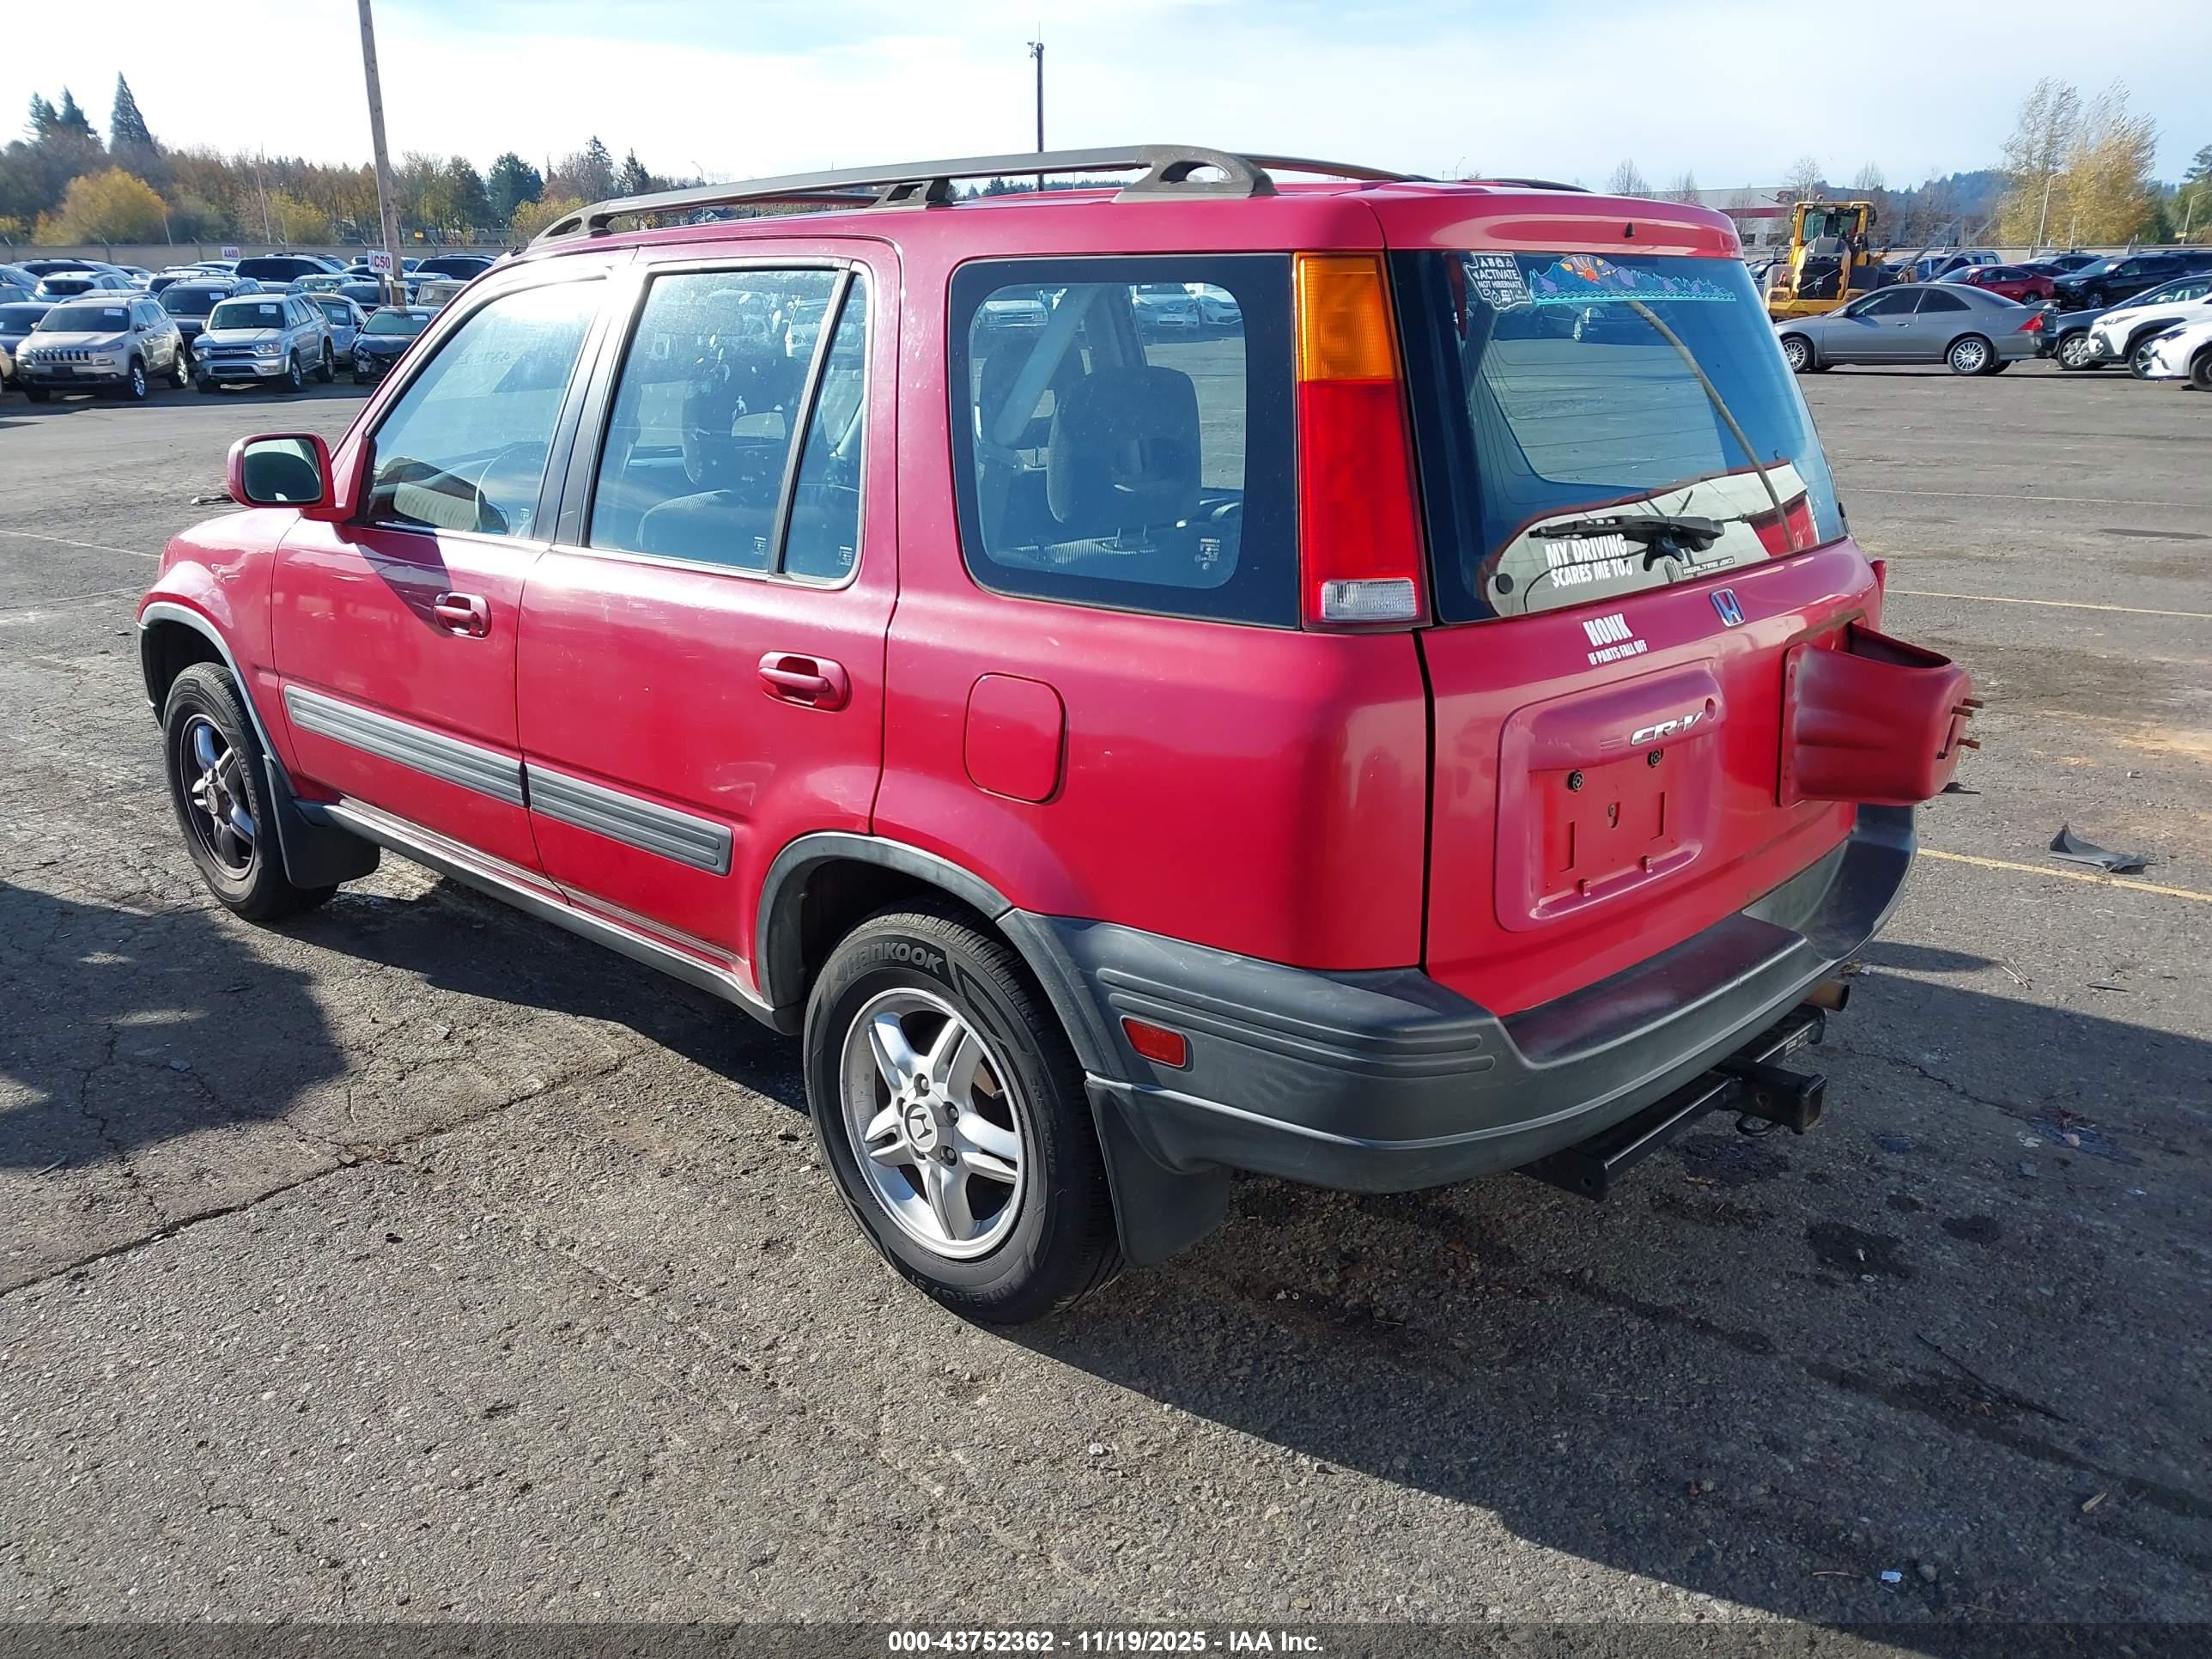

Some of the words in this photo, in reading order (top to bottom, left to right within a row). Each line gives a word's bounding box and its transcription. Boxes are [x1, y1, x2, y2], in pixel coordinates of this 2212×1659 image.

[1477, 280, 1492, 289] NOT
[1545, 541, 1571, 568] MY
[1571, 533, 1627, 562] DRIVING
[1551, 563, 1592, 588] SCARES
[1592, 560, 1611, 581] ME
[1582, 612, 1633, 647] HONK
[1587, 652, 1598, 665] IF
[1595, 646, 1622, 664] PARTS
[1618, 642, 1638, 658] FALL
[1633, 639, 1648, 653] OFF
[1631, 711, 1704, 745] CR-V
